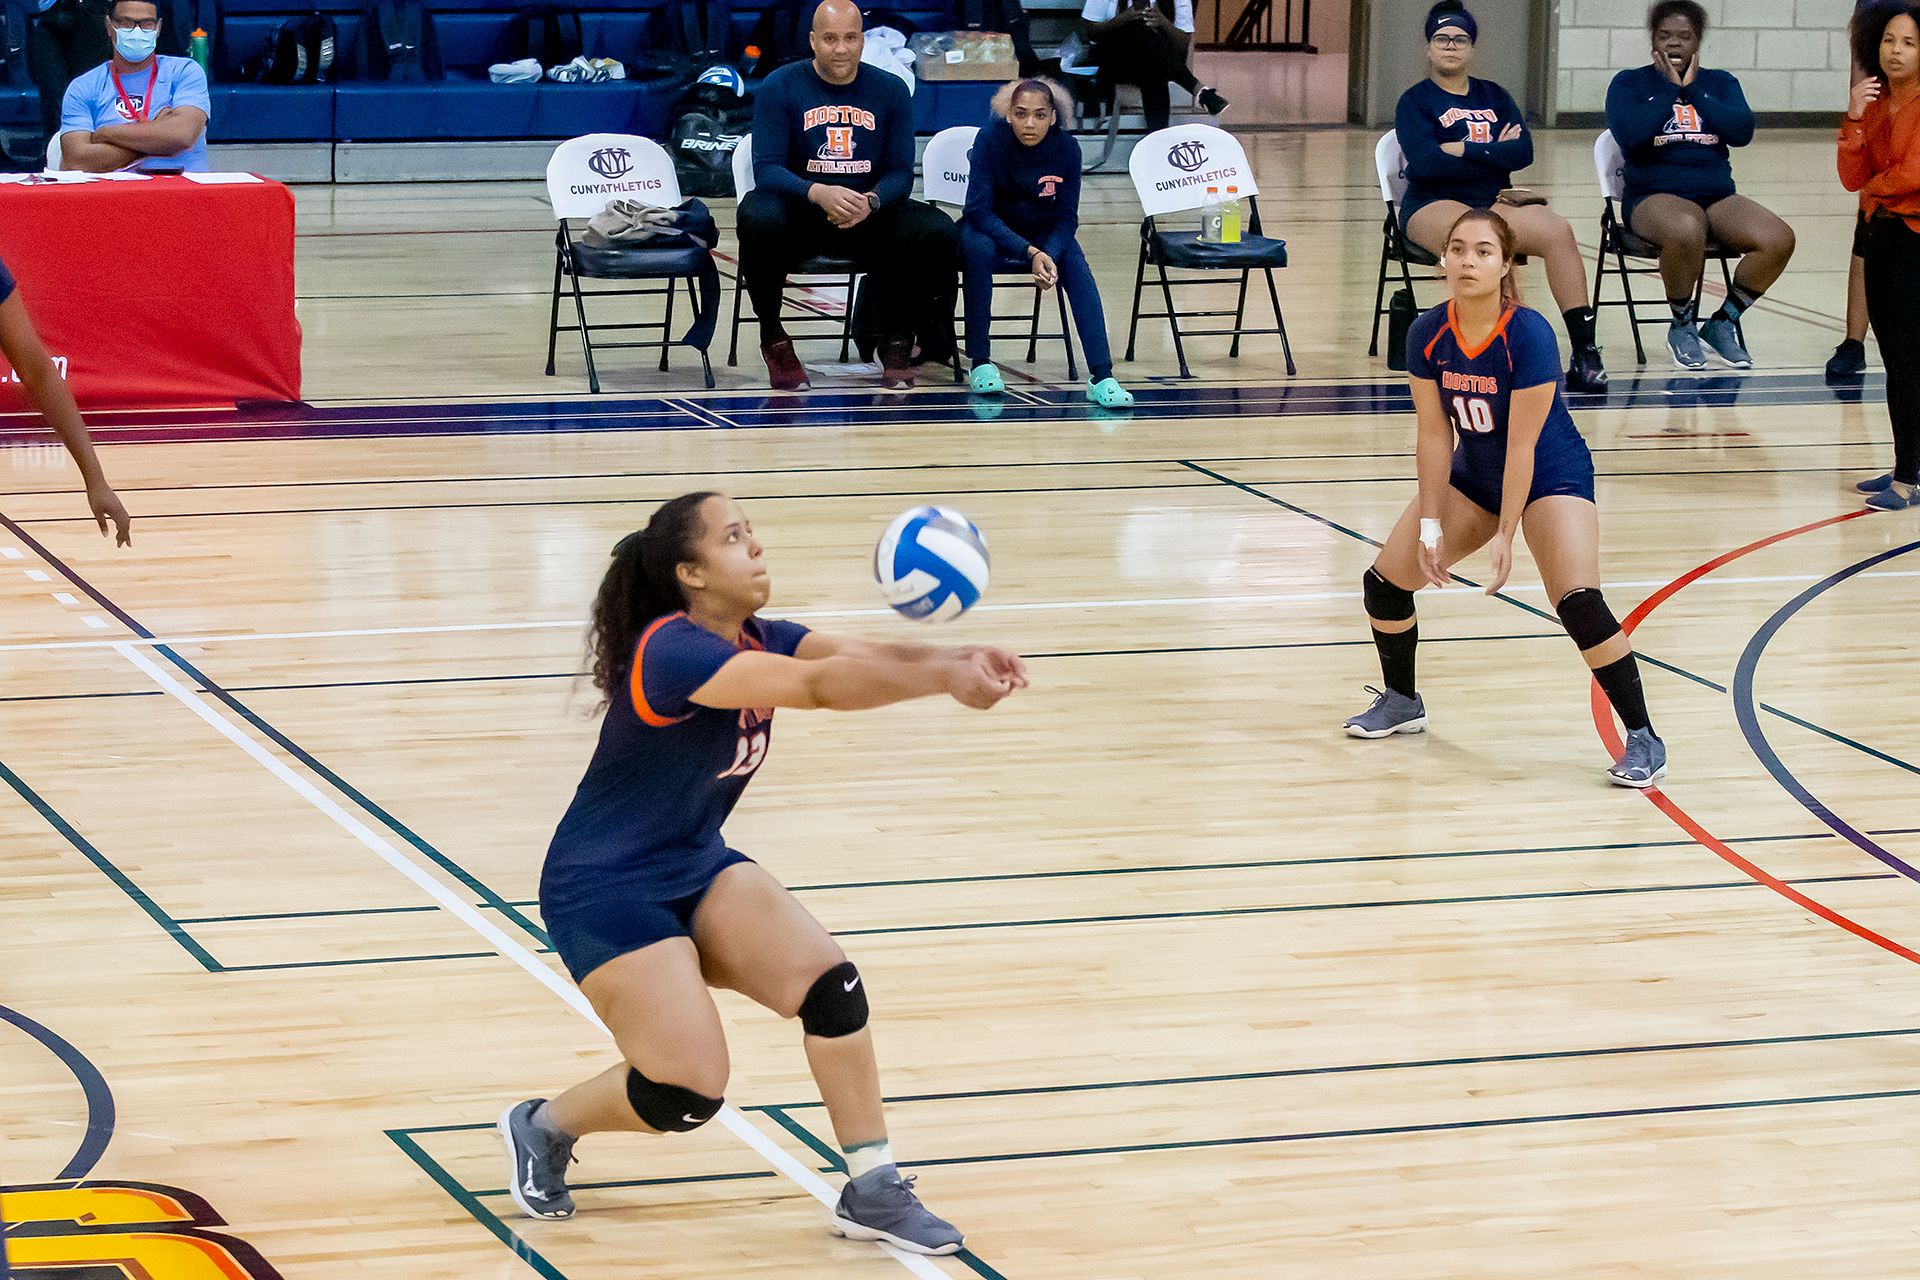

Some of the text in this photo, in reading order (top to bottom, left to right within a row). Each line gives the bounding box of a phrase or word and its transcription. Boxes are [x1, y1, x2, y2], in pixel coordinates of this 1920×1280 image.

[804, 105, 875, 131] HOSTOS
[681, 138, 738, 151] BRINE
[826, 126, 853, 159] H
[806, 159, 871, 173] ATHLETICS
[570, 179, 662, 195] CUNYATHLETICS
[1155, 167, 1237, 192] CUNYATHLETICS
[1442, 371, 1498, 394] HOSTOS
[1452, 395, 1495, 433] 10
